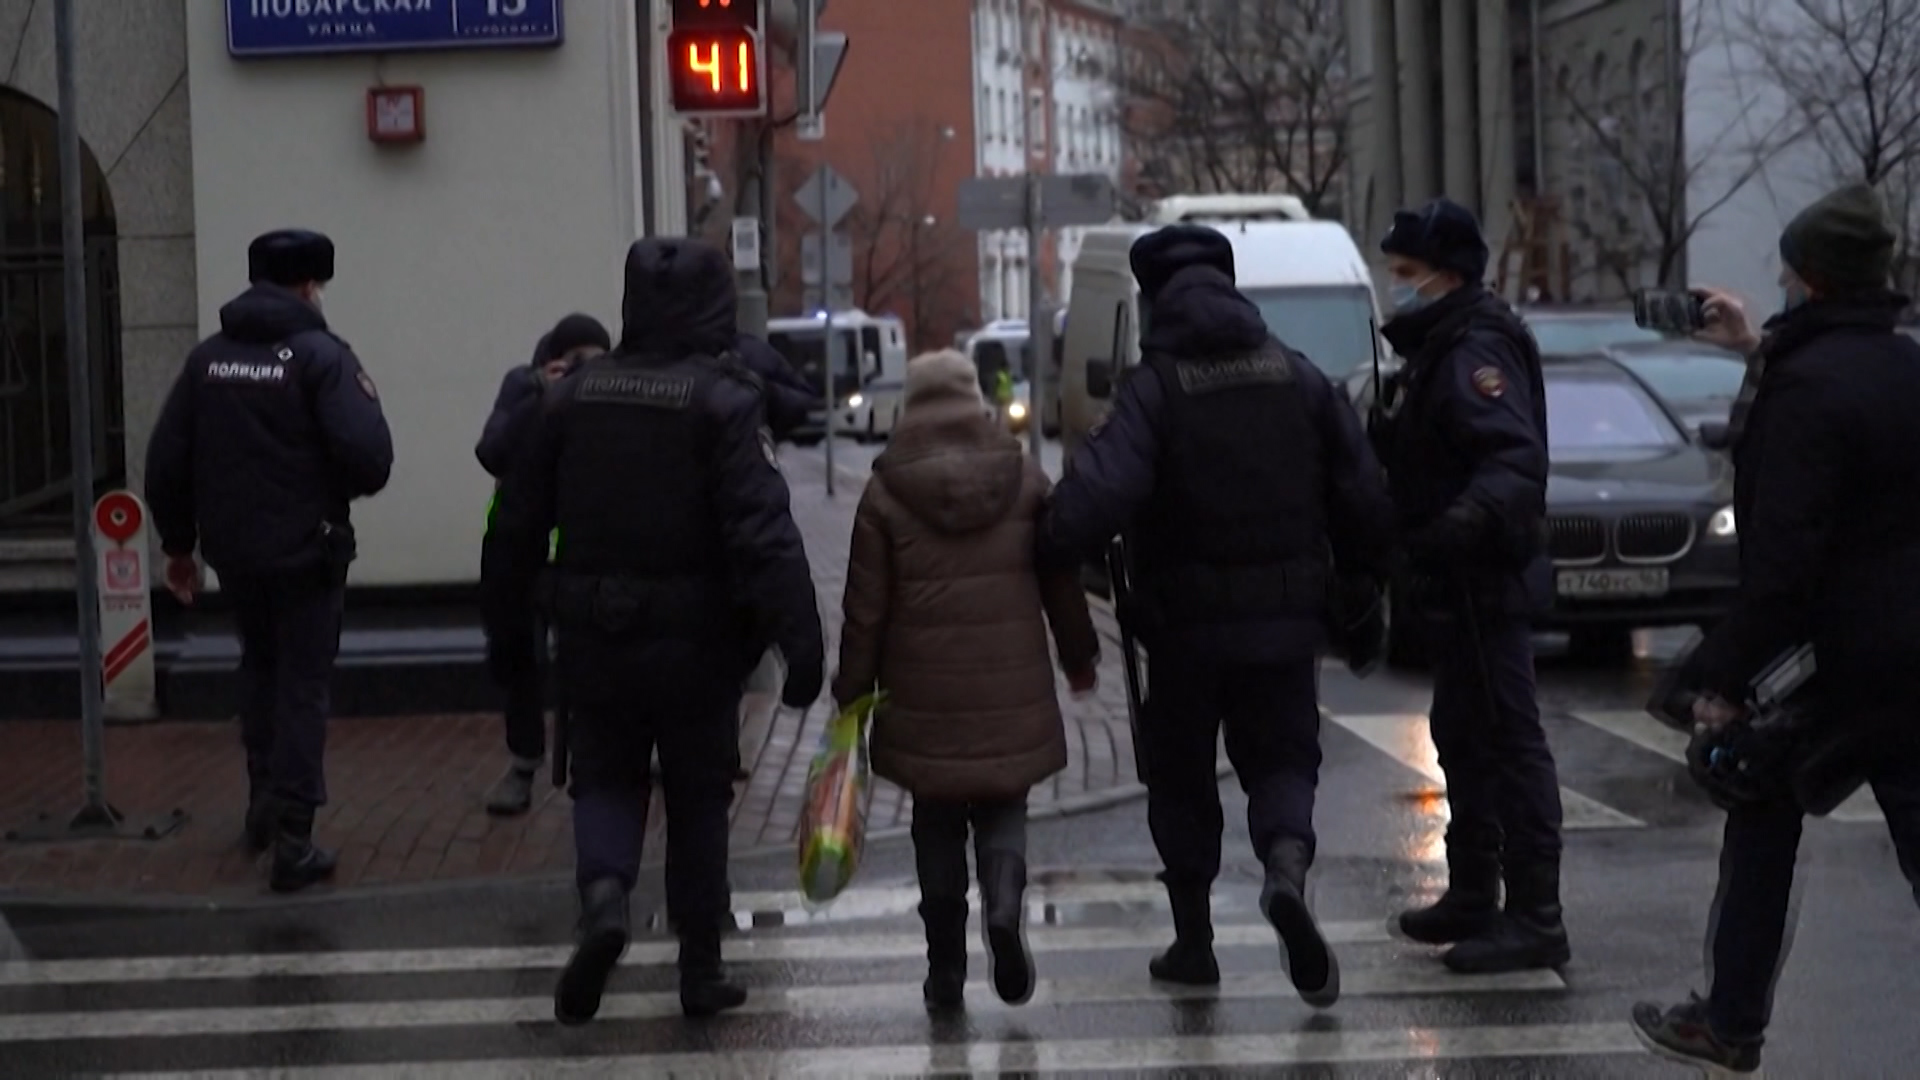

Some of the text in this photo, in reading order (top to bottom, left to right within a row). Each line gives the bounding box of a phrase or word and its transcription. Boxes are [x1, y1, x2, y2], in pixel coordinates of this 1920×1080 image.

[307, 22, 376, 36] УЛИЦА
[688, 40, 749, 94] 41
[207, 361, 286, 381] ПОЛИЦИЯ
